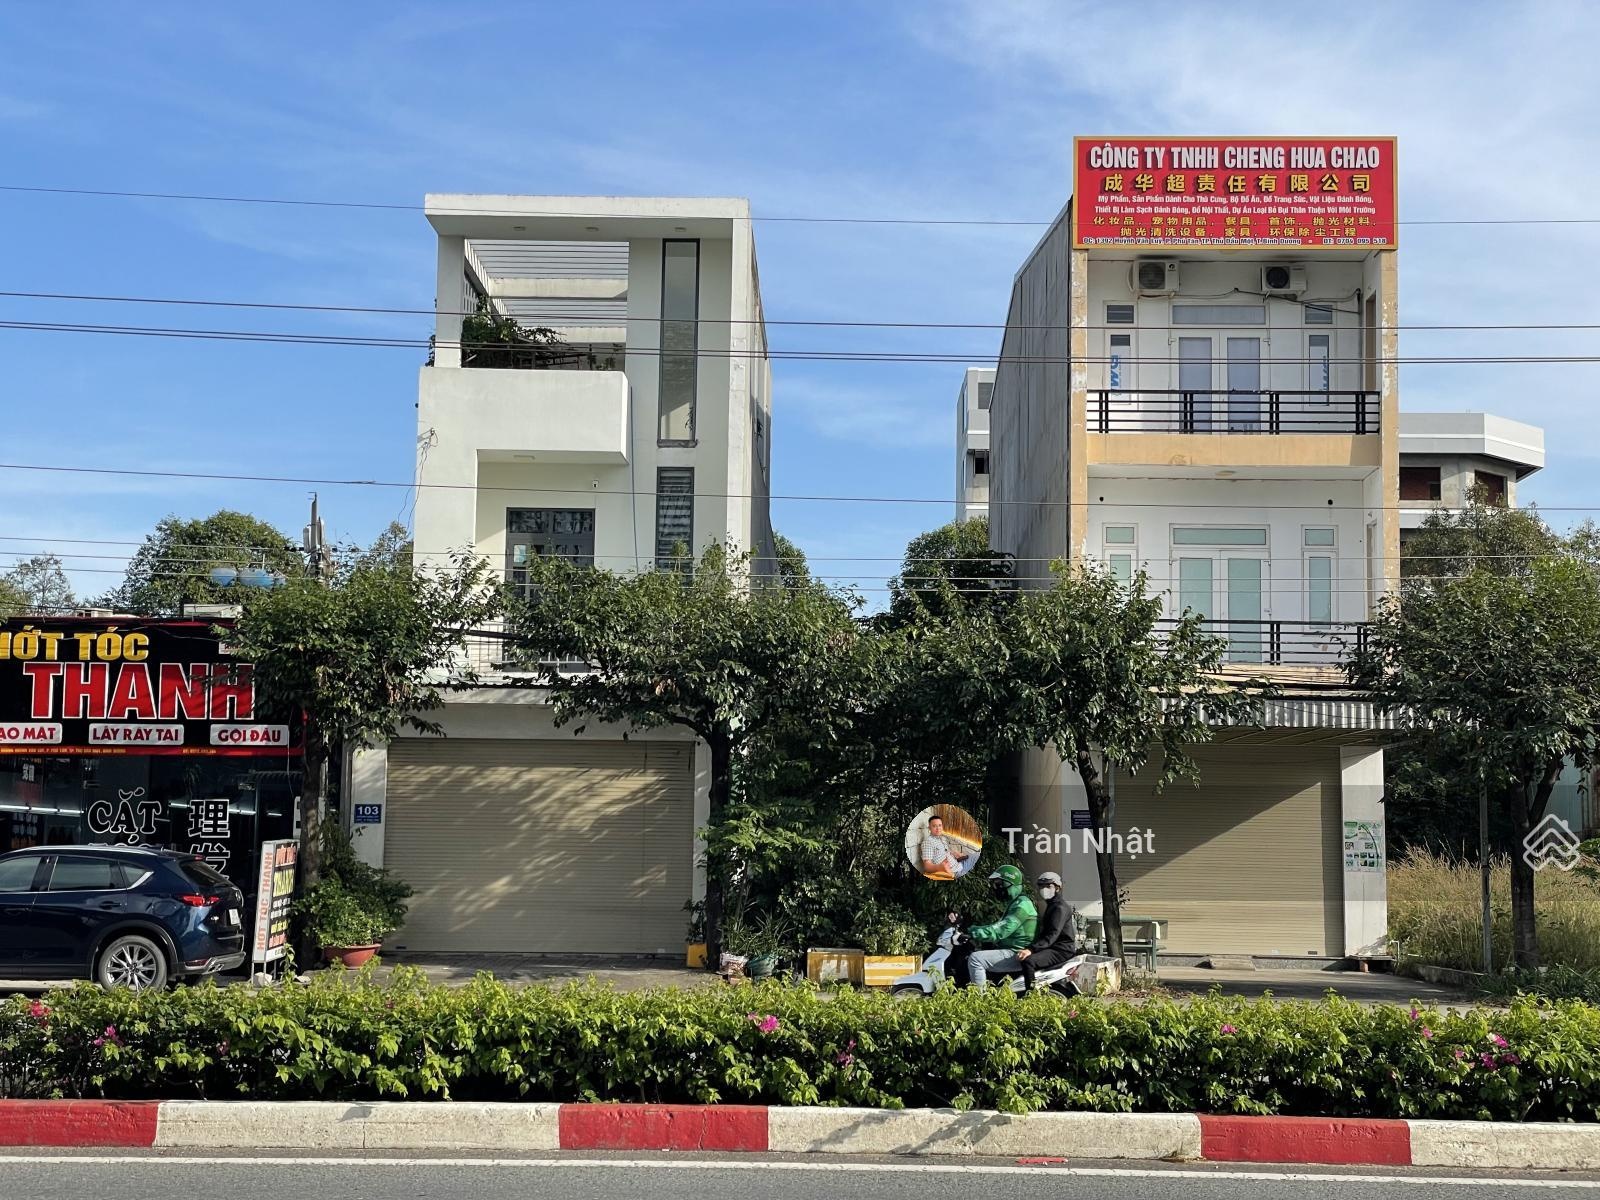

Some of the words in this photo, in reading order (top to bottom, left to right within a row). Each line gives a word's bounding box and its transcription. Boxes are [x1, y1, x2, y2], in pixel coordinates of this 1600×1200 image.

[1090, 143, 1139, 169] CÔNG
[1144, 147, 1166, 169] TY
[1171, 147, 1219, 169] TNHH
[1224, 146, 1285, 169] CHENG
[1290, 147, 1327, 169] HUA
[1331, 146, 1380, 169] CHAO
[1104, 173, 1371, 192] 成华超责任有限公司
[1183, 195, 1195, 203] Cho
[1274, 195, 1292, 204] Trang
[73, 626, 149, 661] TÓC
[23, 662, 255, 720] THANH
[156, 728, 179, 741] TAI
[357, 806, 379, 815] 103
